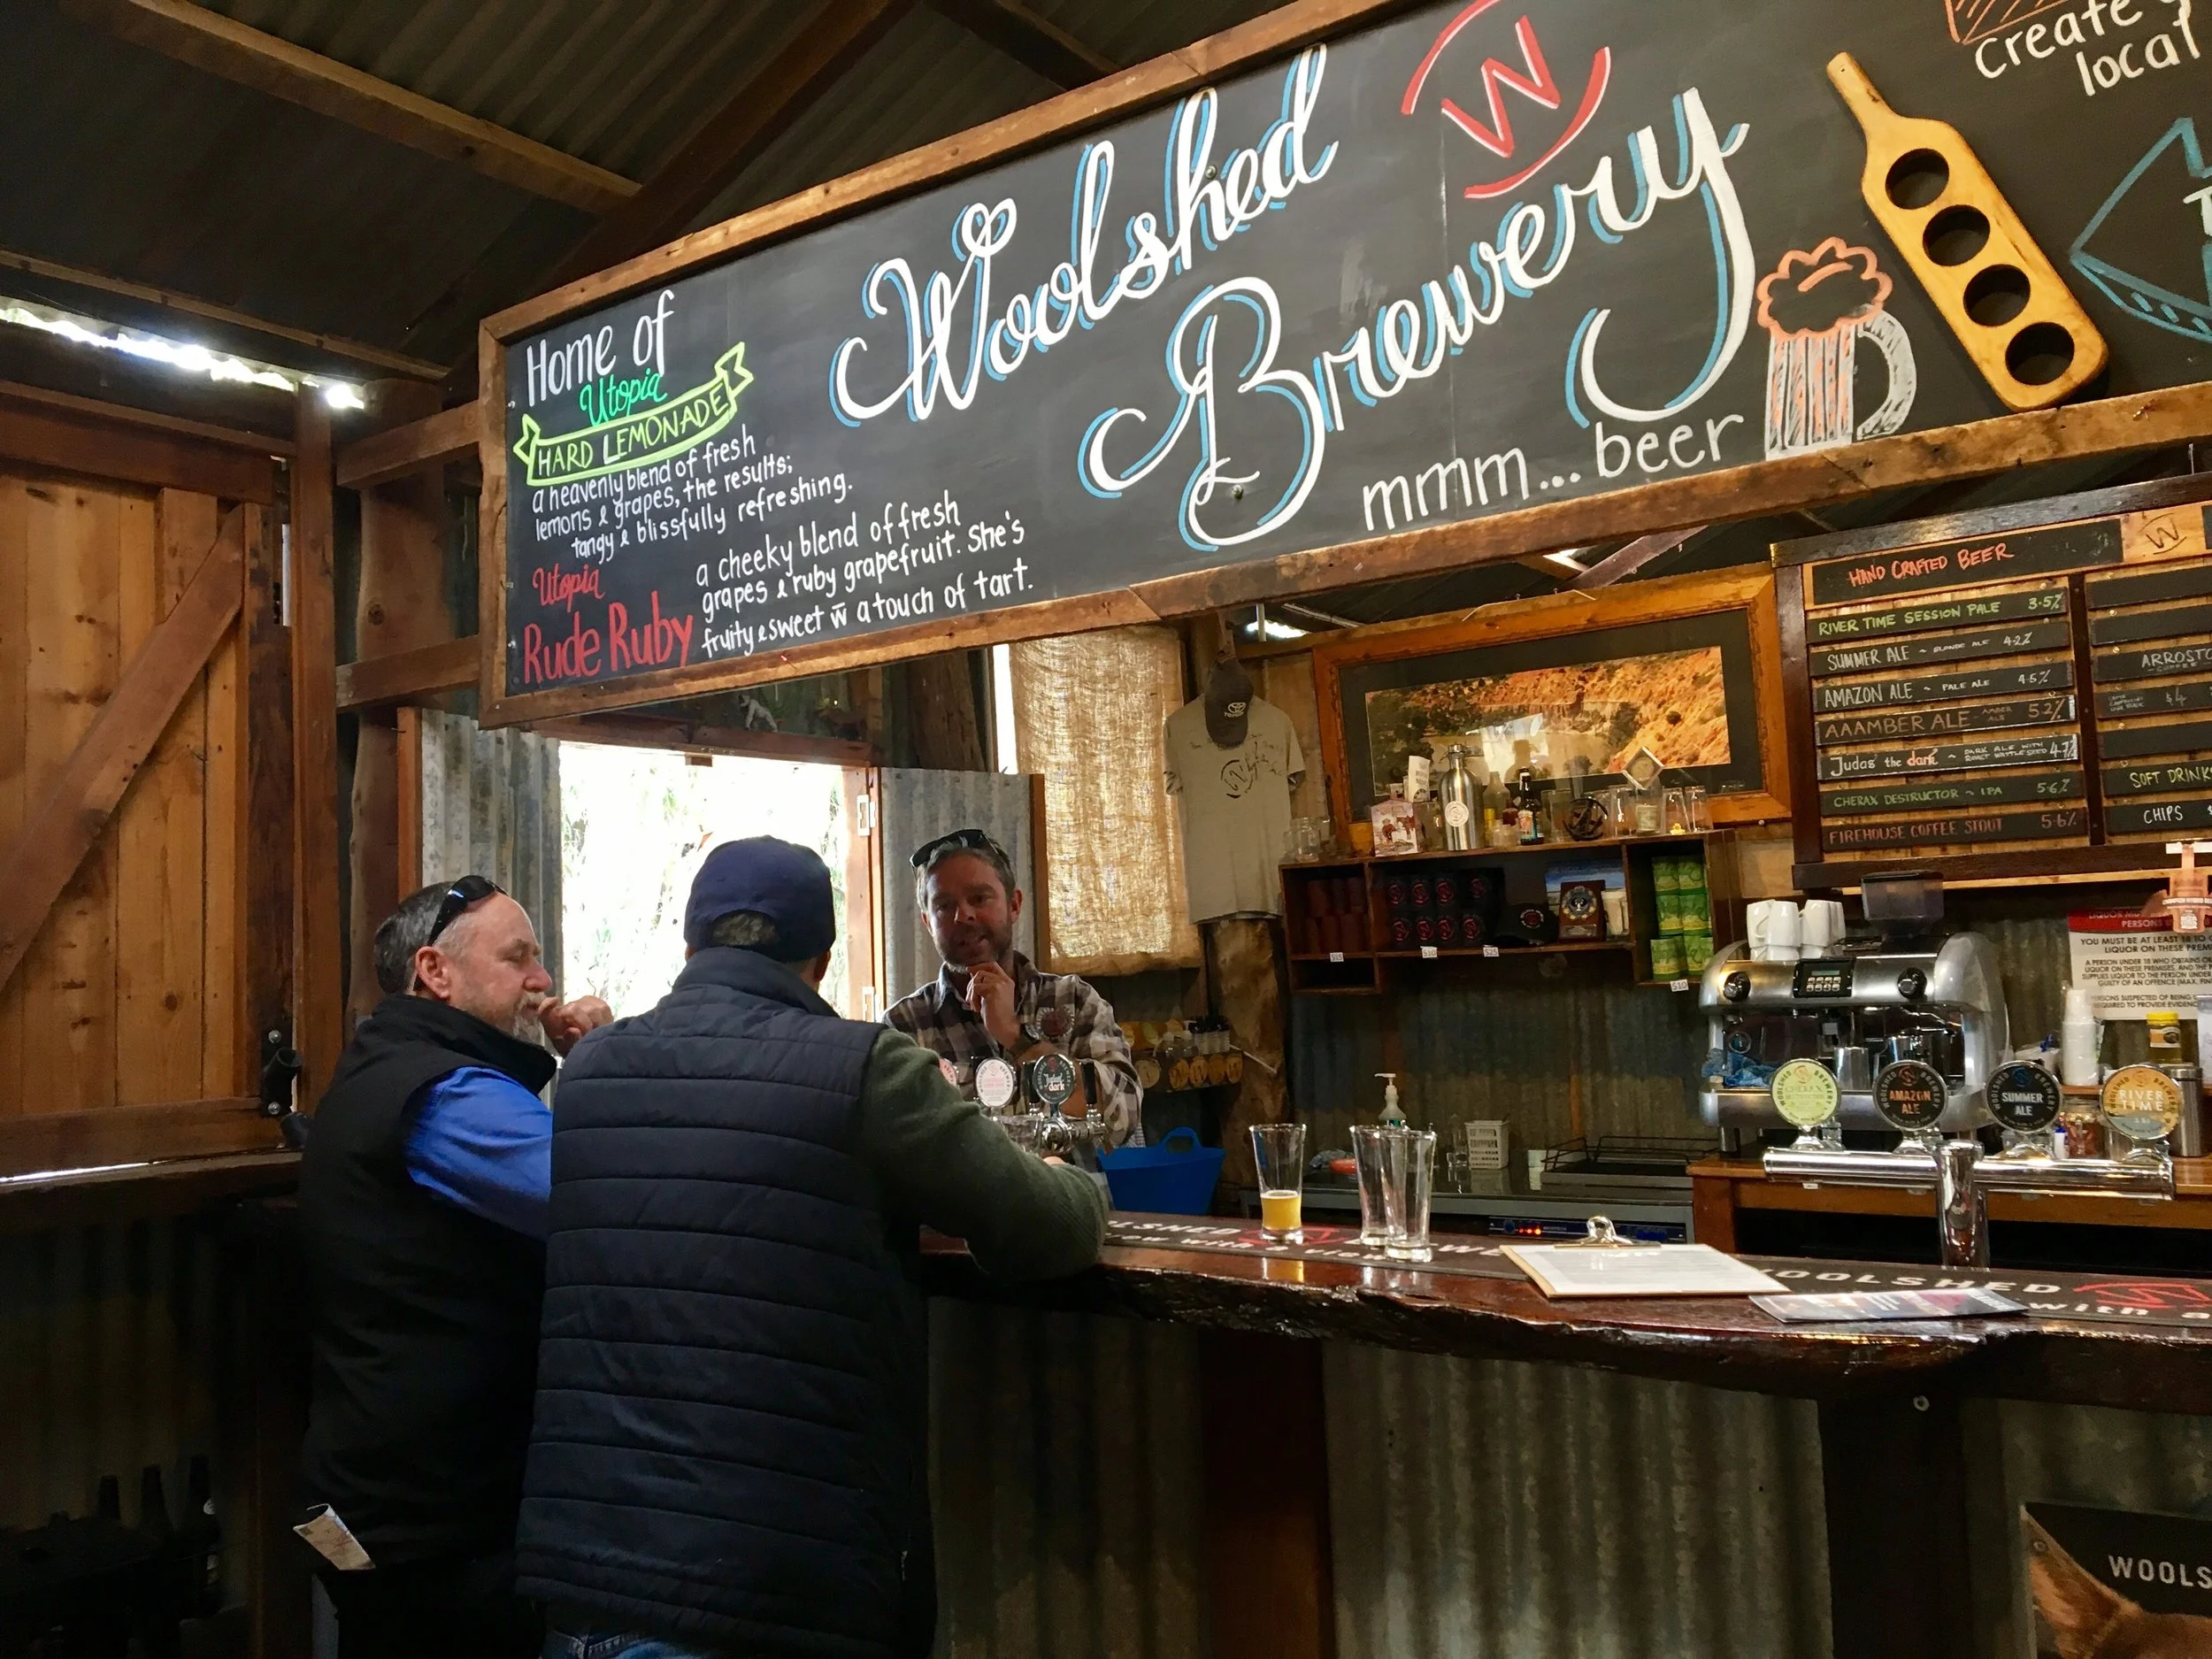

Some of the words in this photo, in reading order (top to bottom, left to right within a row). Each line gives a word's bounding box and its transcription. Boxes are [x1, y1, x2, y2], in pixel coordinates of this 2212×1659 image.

[828, 42, 1340, 427] Woolshed
[1078, 86, 1750, 551] Brewery
[526, 326, 617, 407] Home
[632, 289, 675, 376] of
[580, 368, 668, 426] Utopia
[538, 441, 594, 477] HARD
[602, 382, 729, 465] LEMONADE
[533, 490, 546, 514] a
[549, 472, 623, 511] heavenly
[626, 459, 672, 495] blend
[675, 449, 699, 476] of
[706, 424, 757, 472] fresh
[534, 509, 593, 542] lemons
[682, 479, 718, 504] the
[571, 533, 614, 565] tangy
[636, 498, 726, 545] blissfully
[737, 472, 854, 524] refreshing.
[695, 563, 710, 588] a
[717, 534, 795, 584] cheeky
[798, 511, 859, 558] blend
[870, 502, 893, 545] of
[897, 489, 962, 540] fresh
[701, 580, 769, 624] grapes
[792, 563, 837, 599] ruby
[843, 528, 962, 590] grapefruit.
[968, 510, 1026, 554] She's
[1847, 565, 1886, 588] HAND
[1891, 556, 1947, 580] CRAFTED
[1957, 541, 2016, 571] BEER
[531, 564, 606, 612] Utopia
[701, 623, 756, 659] fruity
[767, 604, 826, 642] sweet
[856, 602, 872, 625] a
[872, 586, 935, 620] touch
[944, 573, 967, 611] of
[972, 557, 1034, 602] tart.
[1818, 618, 1860, 636] RIVER
[1862, 613, 1897, 632] TIME
[1903, 604, 1962, 625] SESSION
[1966, 601, 2002, 618] PALE
[523, 611, 603, 686] Rude
[608, 589, 695, 672] Ruby
[1827, 649, 1882, 672] SUMMER
[1886, 645, 1910, 664] ALE
[1824, 687, 1883, 709] AMAZON
[1890, 682, 1914, 701] ALE
[1941, 681, 1967, 691] PALE
[1971, 679, 1991, 688] ALE
[1824, 715, 1925, 740] AAAMBER
[1930, 710, 1971, 730] ALE
[1884, 756, 1902, 768] the
[2129, 771, 2161, 789] SOFT
[1833, 795, 1879, 809] CHERAX
[1884, 788, 1959, 806] DESTRUCTOR
[2143, 804, 2184, 825] CHIPS
[1829, 825, 1905, 845] FIREHOUSE
[1909, 819, 1957, 839] COFFEE
[1963, 817, 2004, 834] STOUT
[1901, 1103, 1921, 1115] ALE
[2001, 1092, 2044, 1104] SUMMER
[2014, 1105, 2033, 1117] ALE
[2118, 1089, 2164, 1101] RIVER
[2120, 1100, 2164, 1111] TIME
[2029, 1302, 2150, 1317] with
